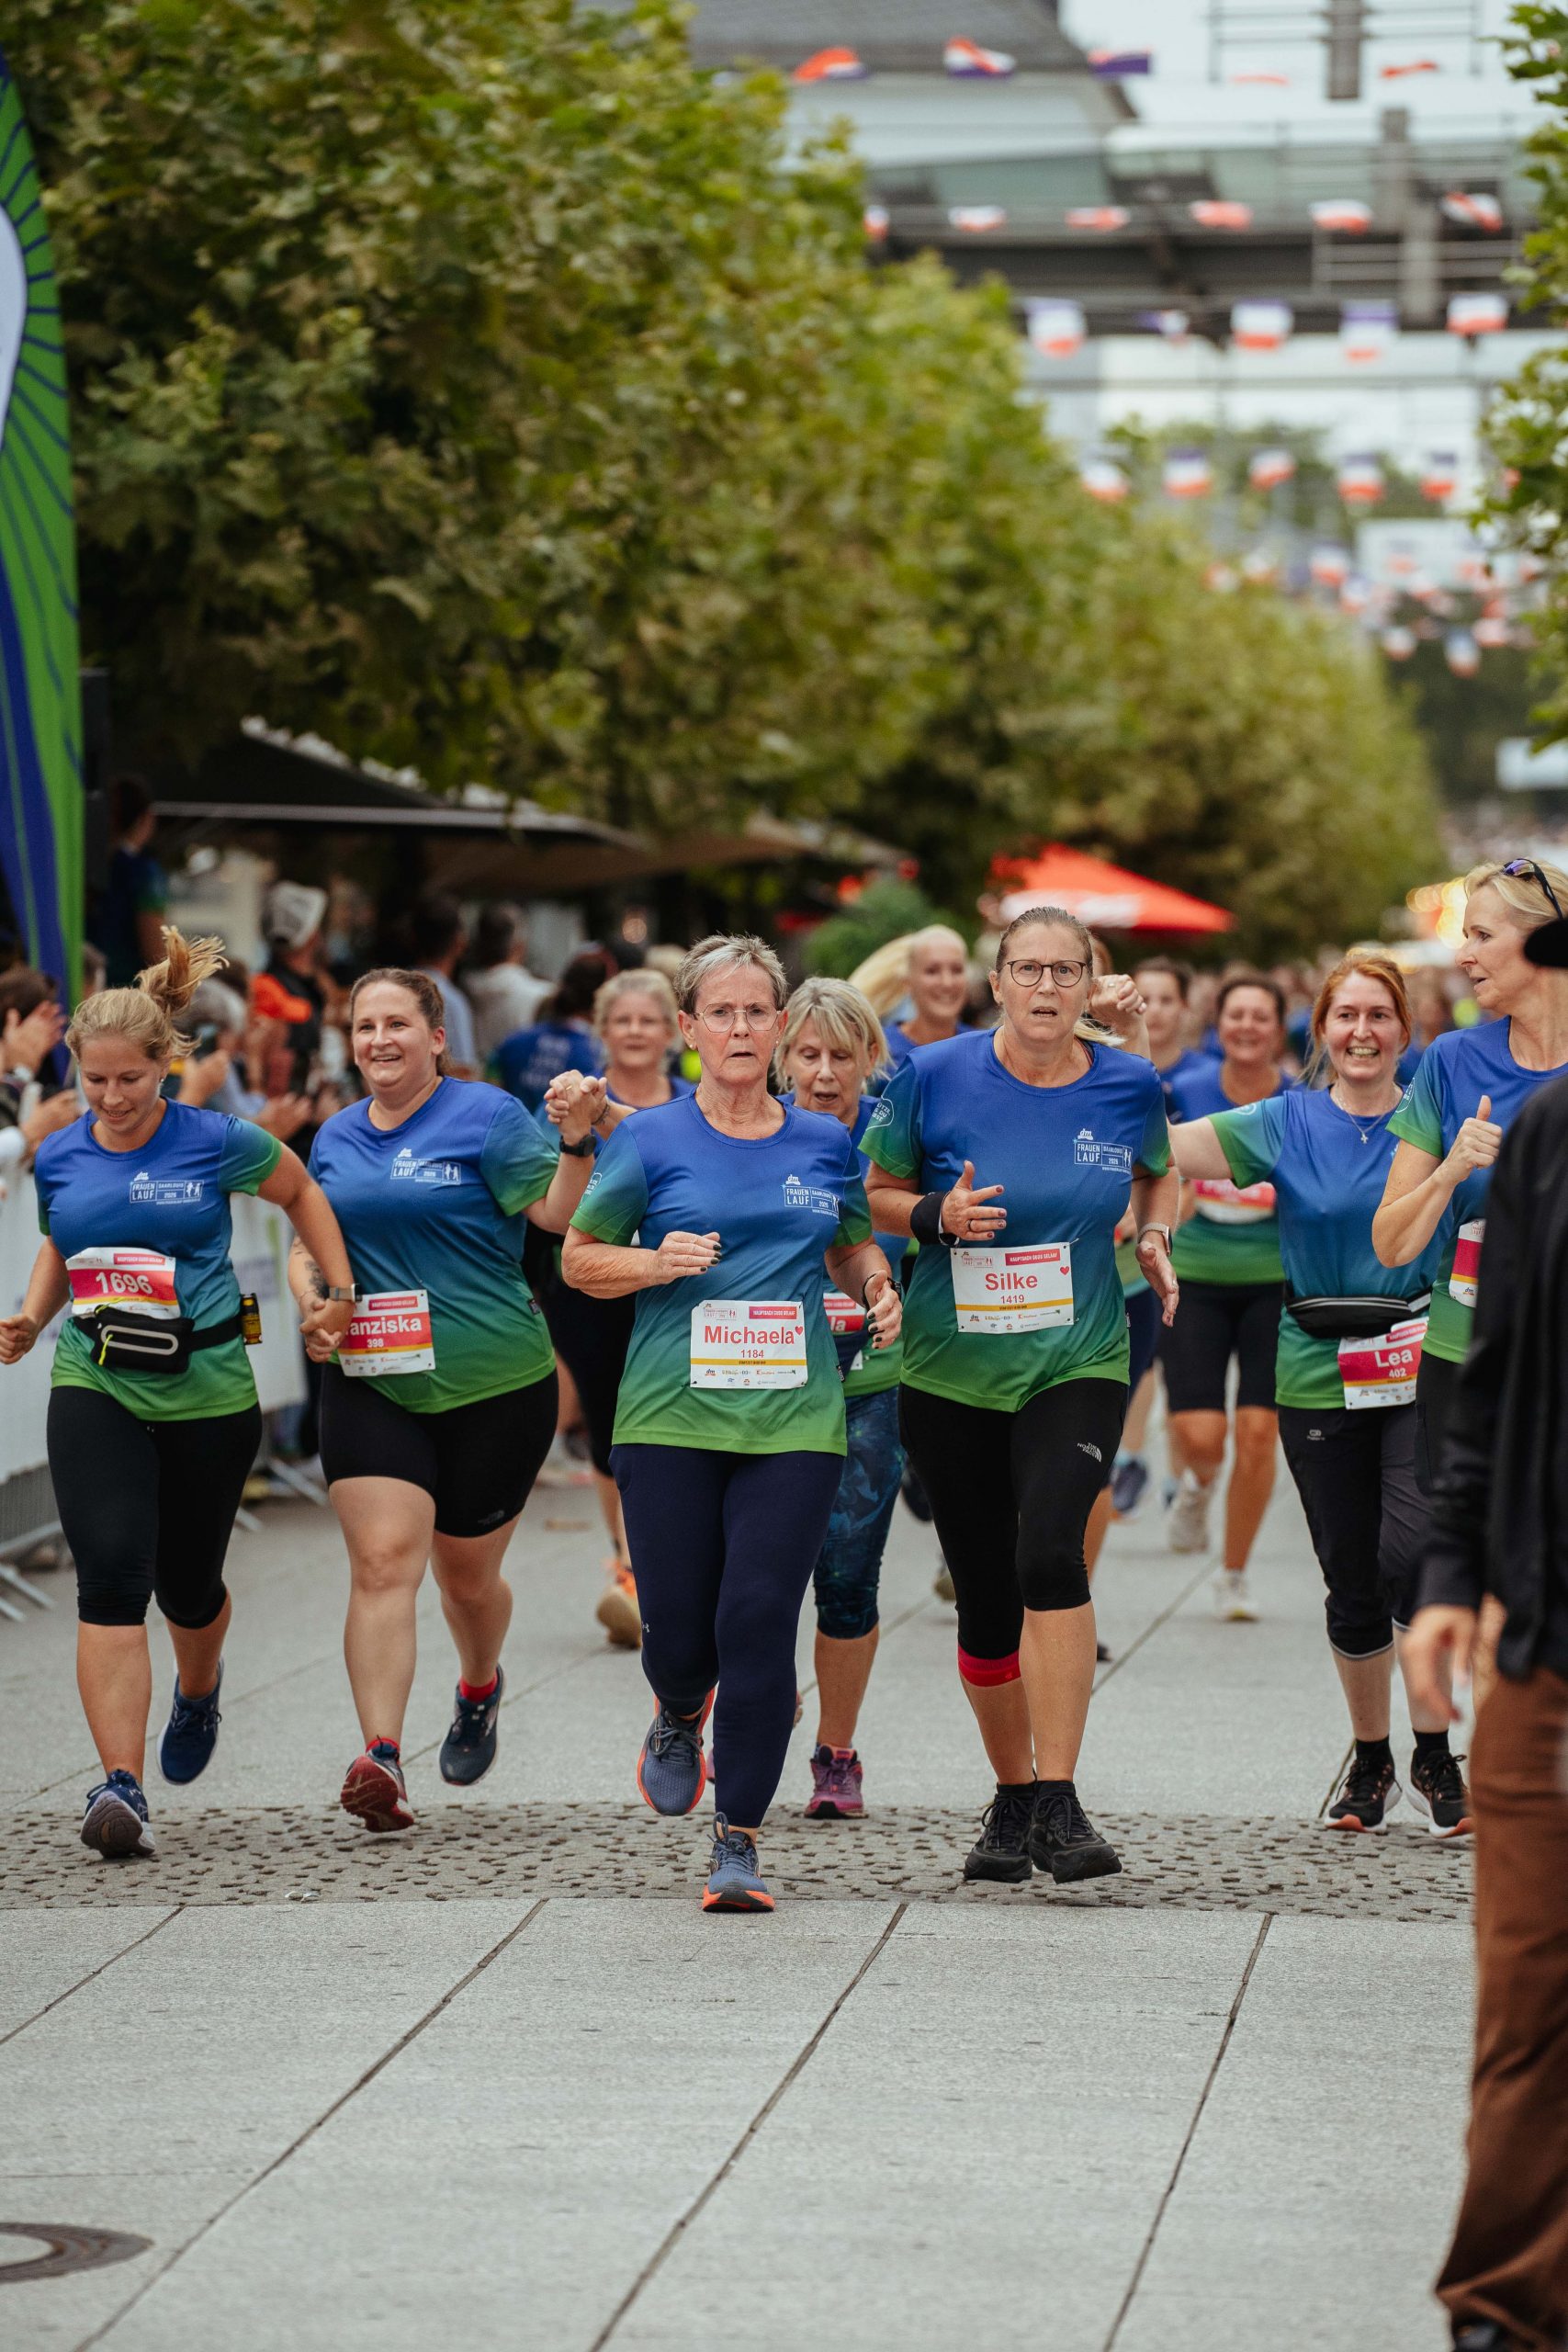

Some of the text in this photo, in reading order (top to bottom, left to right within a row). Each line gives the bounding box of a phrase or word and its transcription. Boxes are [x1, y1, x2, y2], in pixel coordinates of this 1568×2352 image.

[1077, 1144, 1100, 1152] FRAUEN
[1077, 1152, 1100, 1162] LAUF
[393, 1167, 415, 1177] LAUF
[132, 1182, 155, 1191] FRAUEN
[131, 1191, 155, 1200] LAUF
[786, 1188, 809, 1196] FRAUEN
[786, 1195, 809, 1205] LAUF
[96, 1272, 153, 1295] 1696
[985, 1272, 1038, 1291] Silke
[1000, 1295, 1025, 1304] 1419
[345, 1315, 423, 1336] anziska
[704, 1325, 795, 1344] Michaela
[367, 1338, 384, 1348] 398
[740, 1350, 764, 1358] 1184
[1374, 1349, 1414, 1367] Lea
[1389, 1368, 1406, 1378] 402
